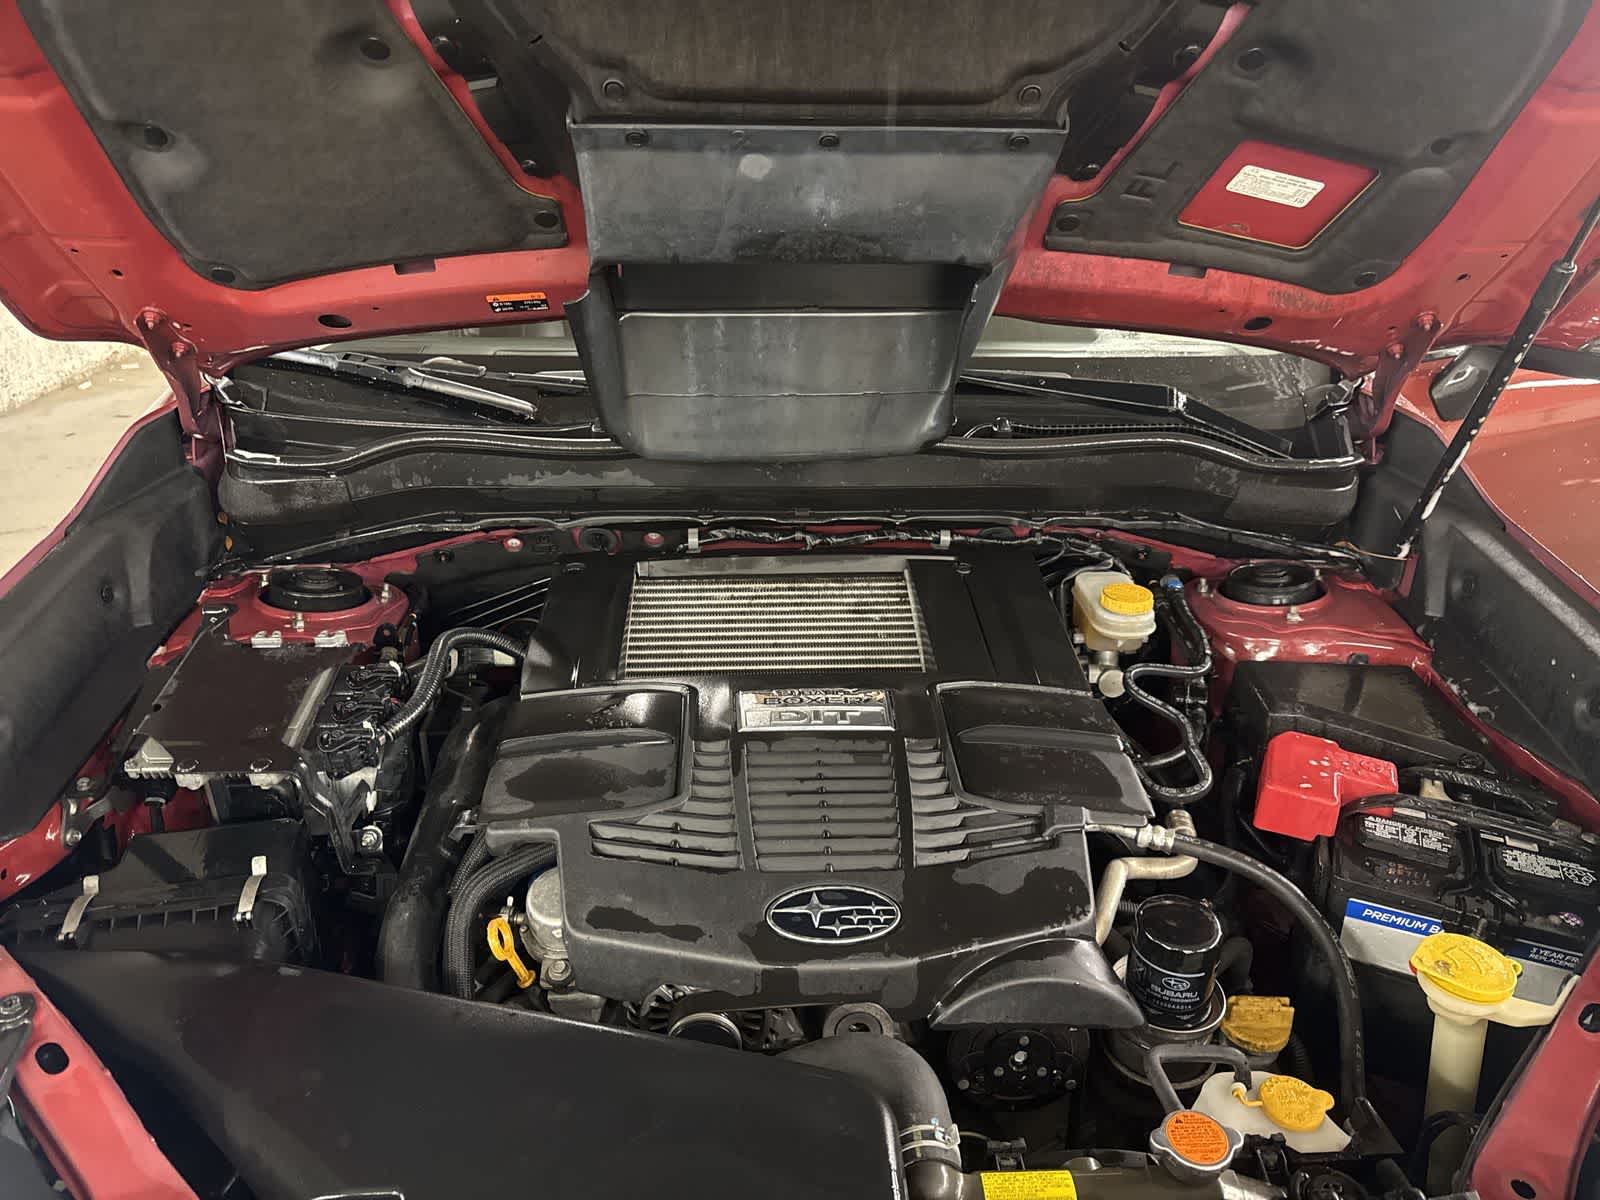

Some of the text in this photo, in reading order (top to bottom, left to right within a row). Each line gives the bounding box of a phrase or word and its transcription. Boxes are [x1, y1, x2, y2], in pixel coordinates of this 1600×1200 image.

[764, 695, 864, 705] BOXER
[773, 709, 862, 724] DIT
[1362, 908, 1445, 934] PREMIUM B
[1540, 949, 1565, 960] YEAR
[1151, 984, 1198, 999] SUBARU
